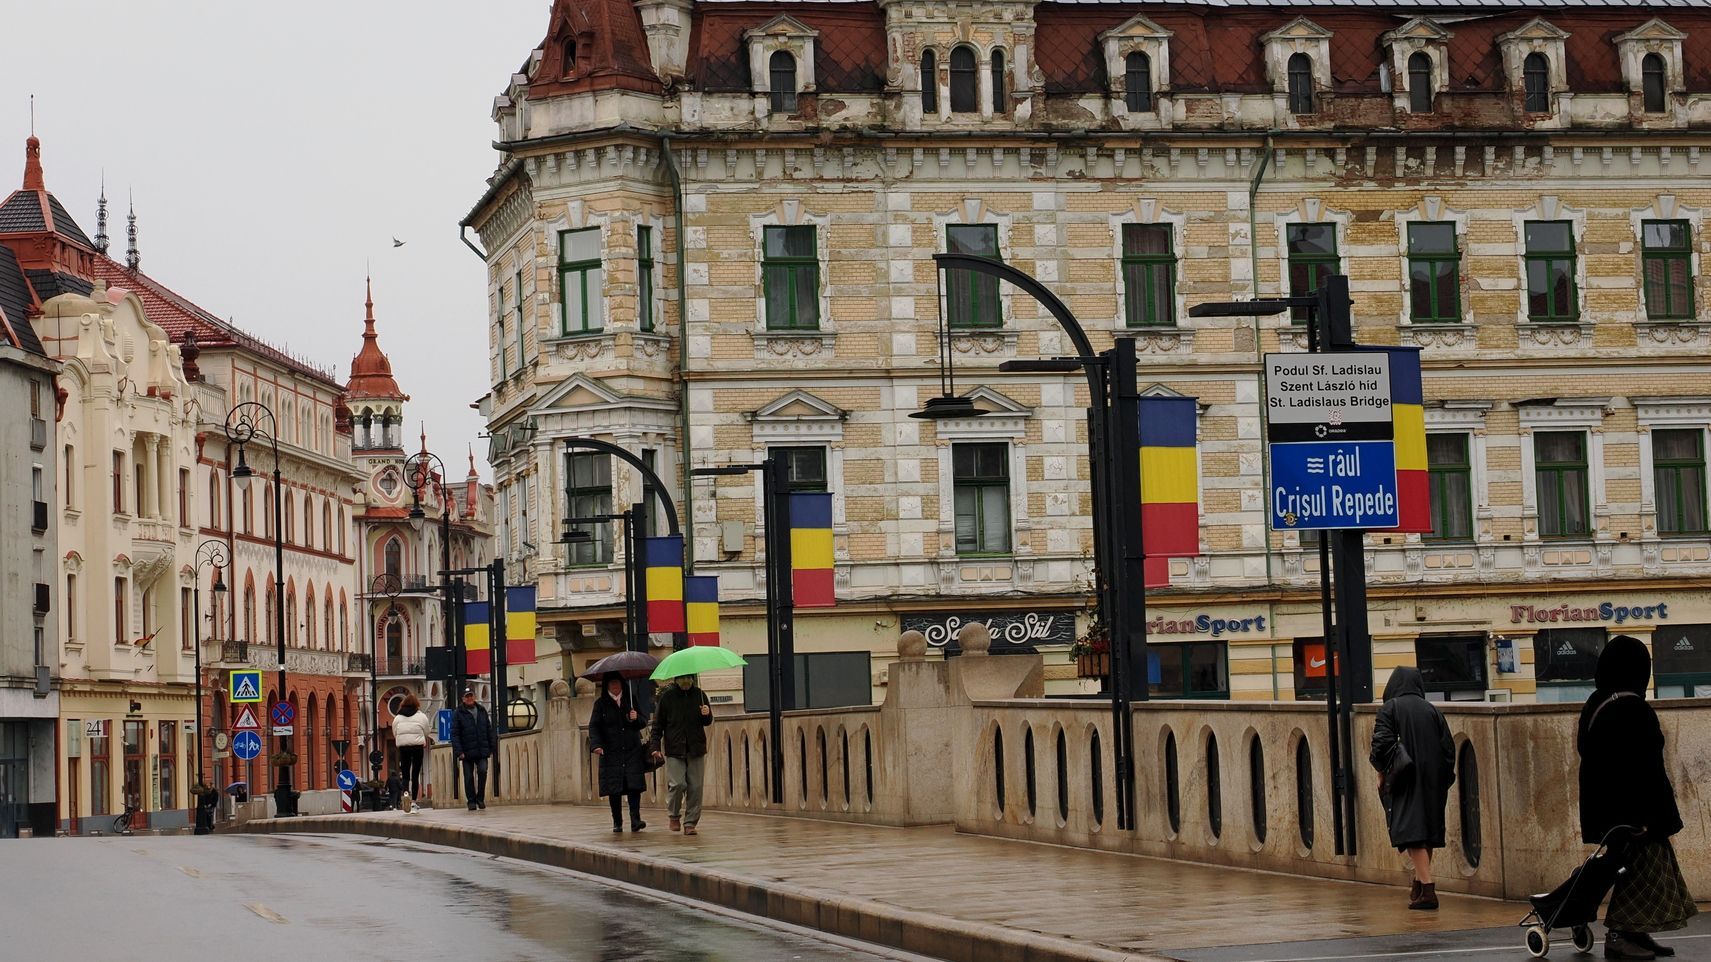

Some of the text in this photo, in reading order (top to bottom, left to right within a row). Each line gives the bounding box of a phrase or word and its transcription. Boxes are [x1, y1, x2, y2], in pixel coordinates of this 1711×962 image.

[1274, 365, 1381, 376] Podul Sf. Ladislau
[1280, 380, 1377, 391] Szent László híd
[1270, 396, 1389, 408] St. Ladislaus Bridge
[1329, 446, 1360, 477] râul
[1275, 484, 1394, 524] Crișul Repede
[1511, 602, 1668, 624] FlorianSport
[1005, 612, 1054, 644] Stil
[1146, 614, 1266, 637] rianSport
